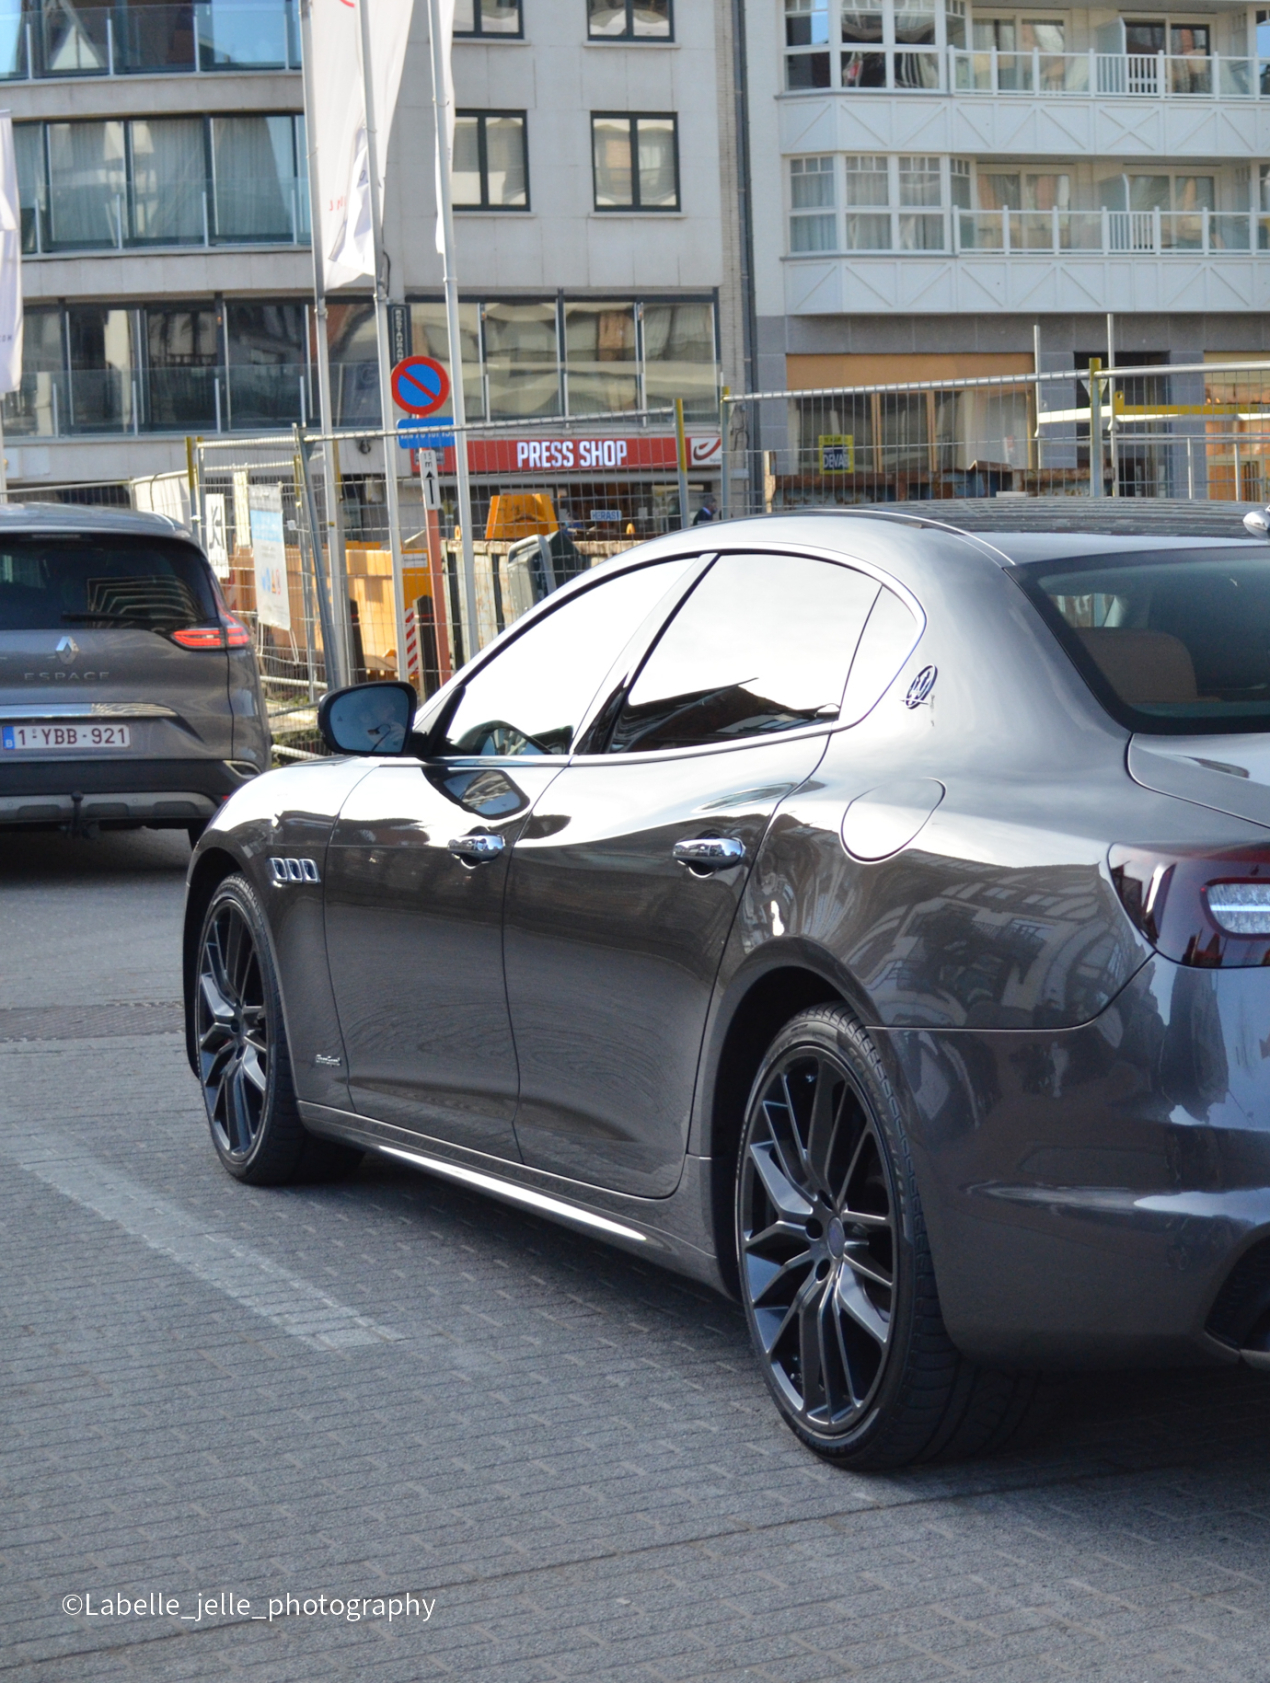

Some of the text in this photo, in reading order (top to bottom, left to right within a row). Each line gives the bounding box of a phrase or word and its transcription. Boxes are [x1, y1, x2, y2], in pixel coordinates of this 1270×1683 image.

[517, 440, 627, 468] PRESS SHOP
[24, 671, 110, 682] ESPACE
[5, 738, 14, 748] B
[17, 727, 126, 746] 1-YBB-921
